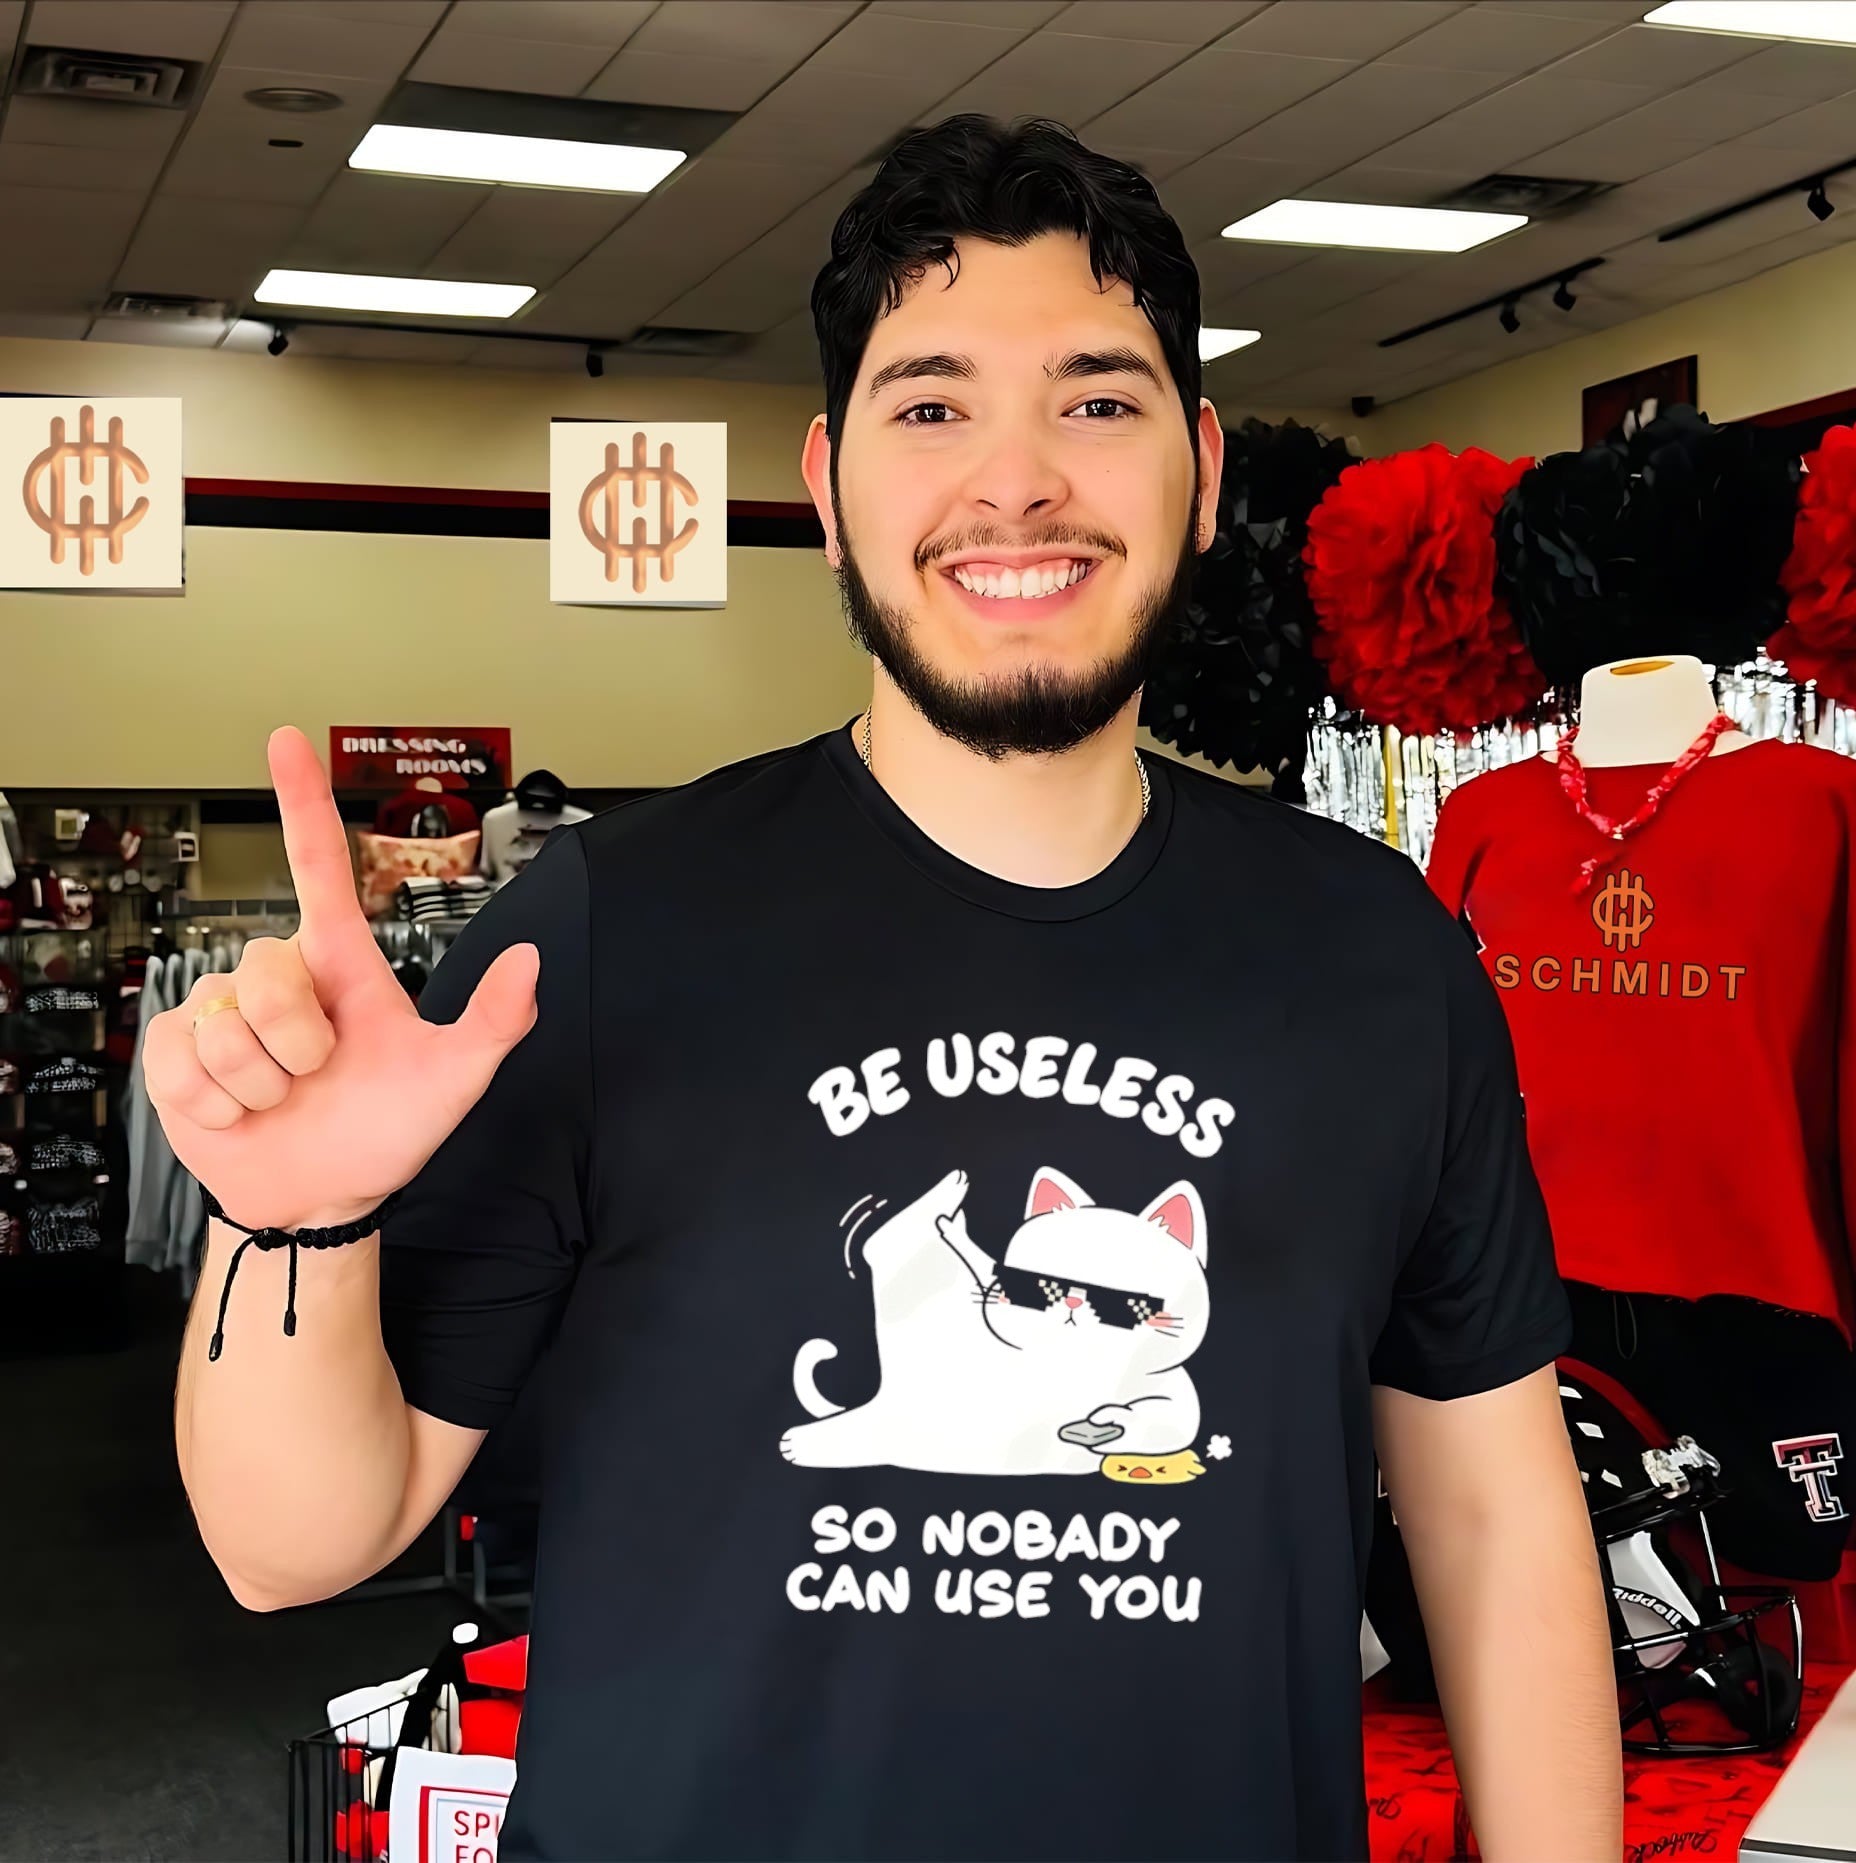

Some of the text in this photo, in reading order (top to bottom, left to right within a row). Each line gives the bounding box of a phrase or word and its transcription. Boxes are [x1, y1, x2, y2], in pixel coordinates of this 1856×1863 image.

[1494, 954, 1746, 999] SCHMIDT
[807, 1031, 1236, 1158] BE USELESS
[811, 1504, 1181, 1563] SO NOBADY
[785, 1562, 1203, 1623] CAN USE YOU
